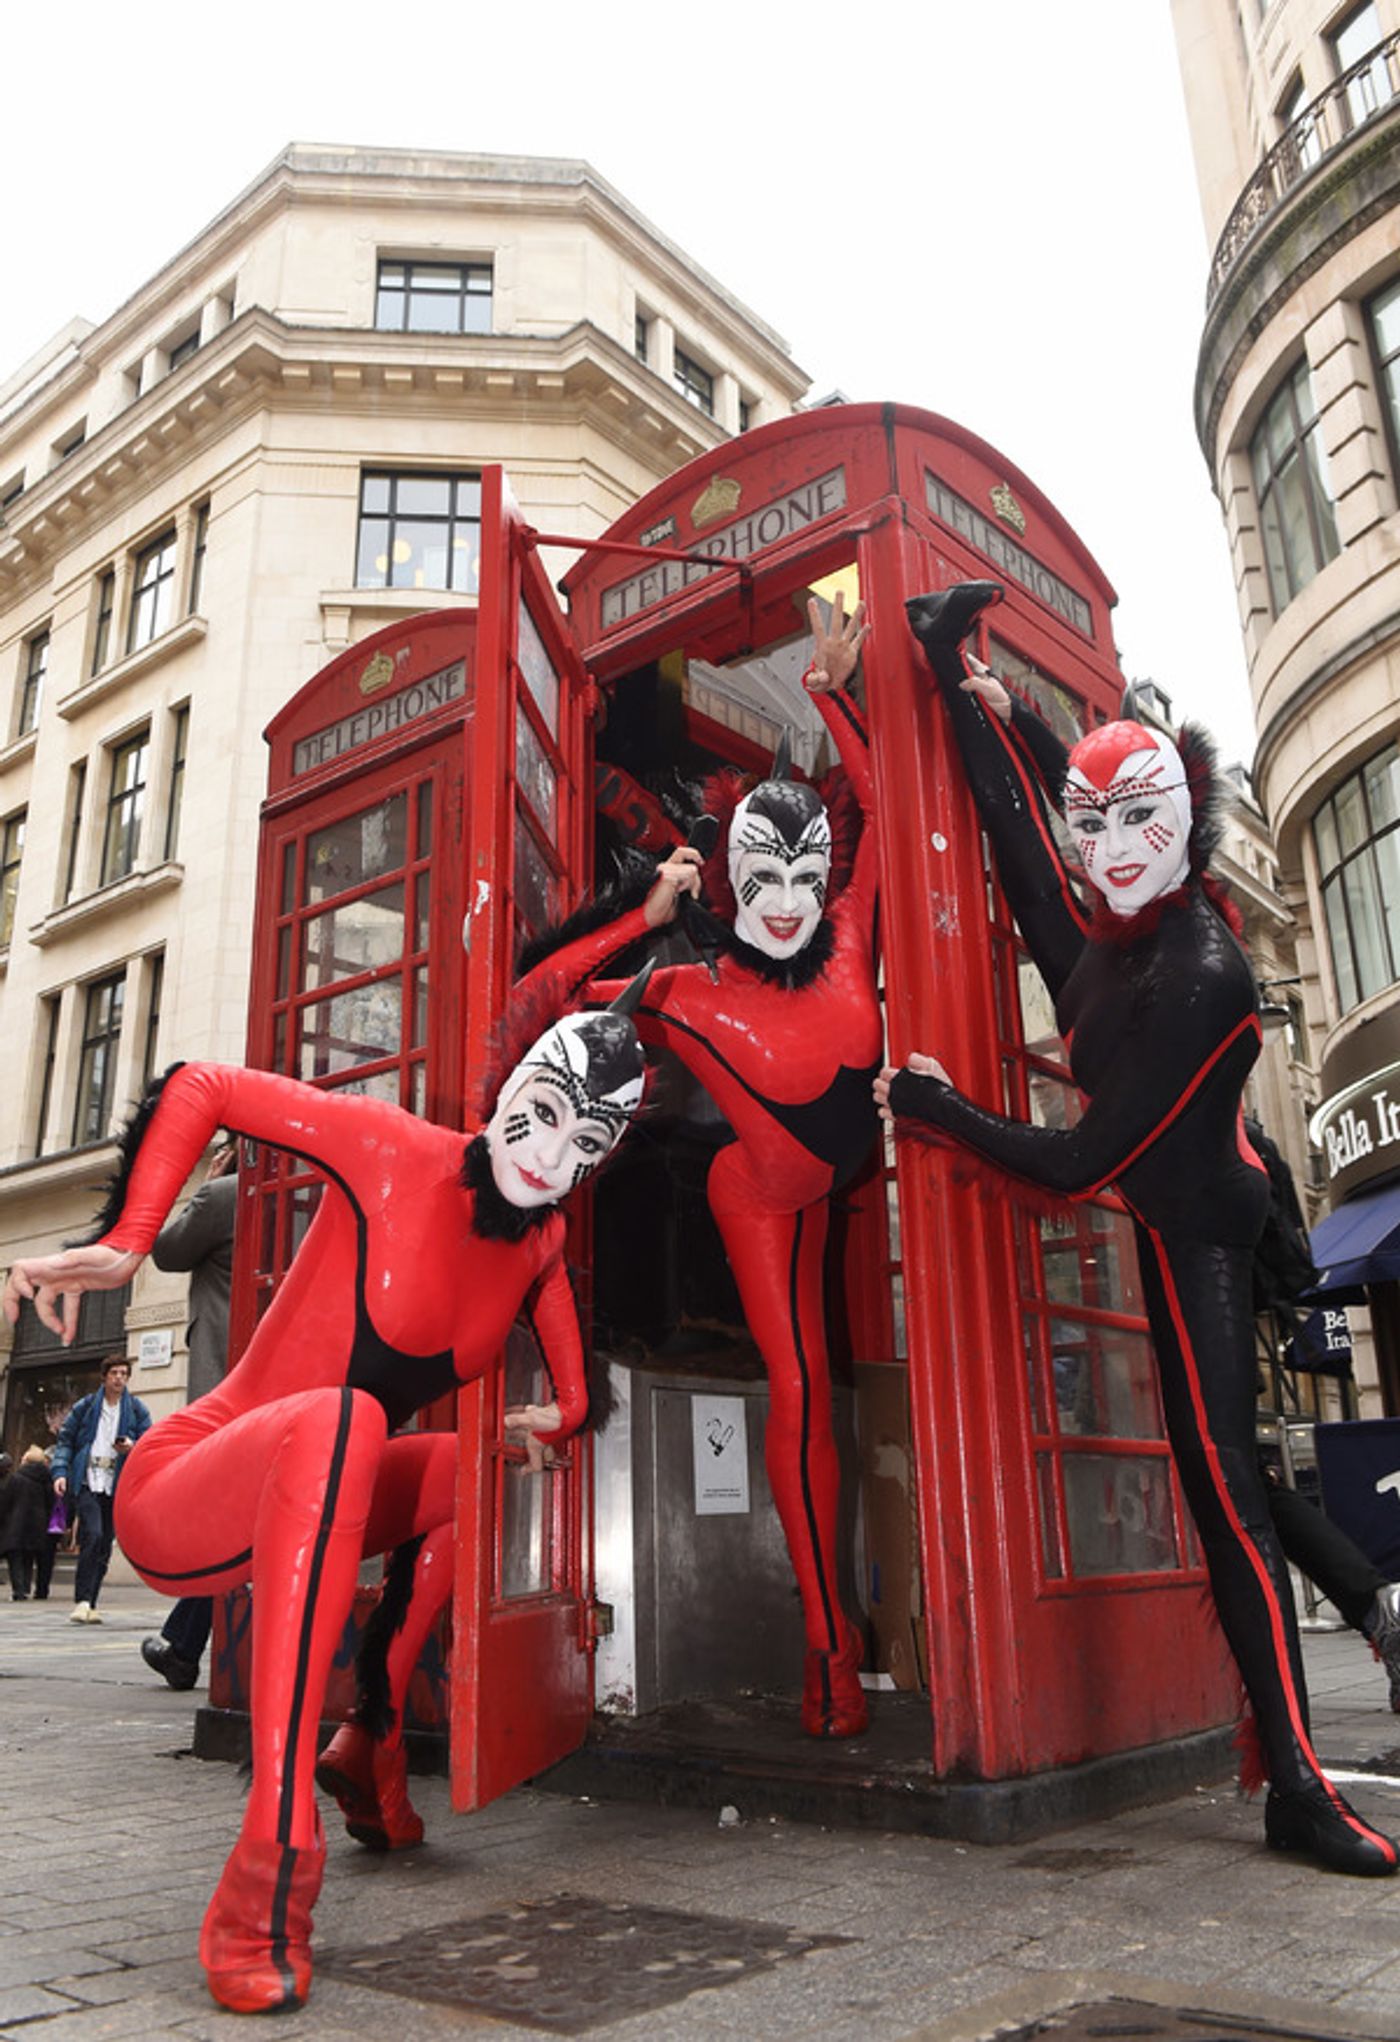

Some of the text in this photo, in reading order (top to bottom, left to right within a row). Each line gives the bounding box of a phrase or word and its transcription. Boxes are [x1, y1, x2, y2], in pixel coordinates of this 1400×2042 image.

[612, 475, 839, 620] TELEPHONE
[928, 480, 1087, 629] TELEPHONE
[303, 665, 462, 775] TELEPHONE
[1325, 1108, 1374, 1179] Bella
